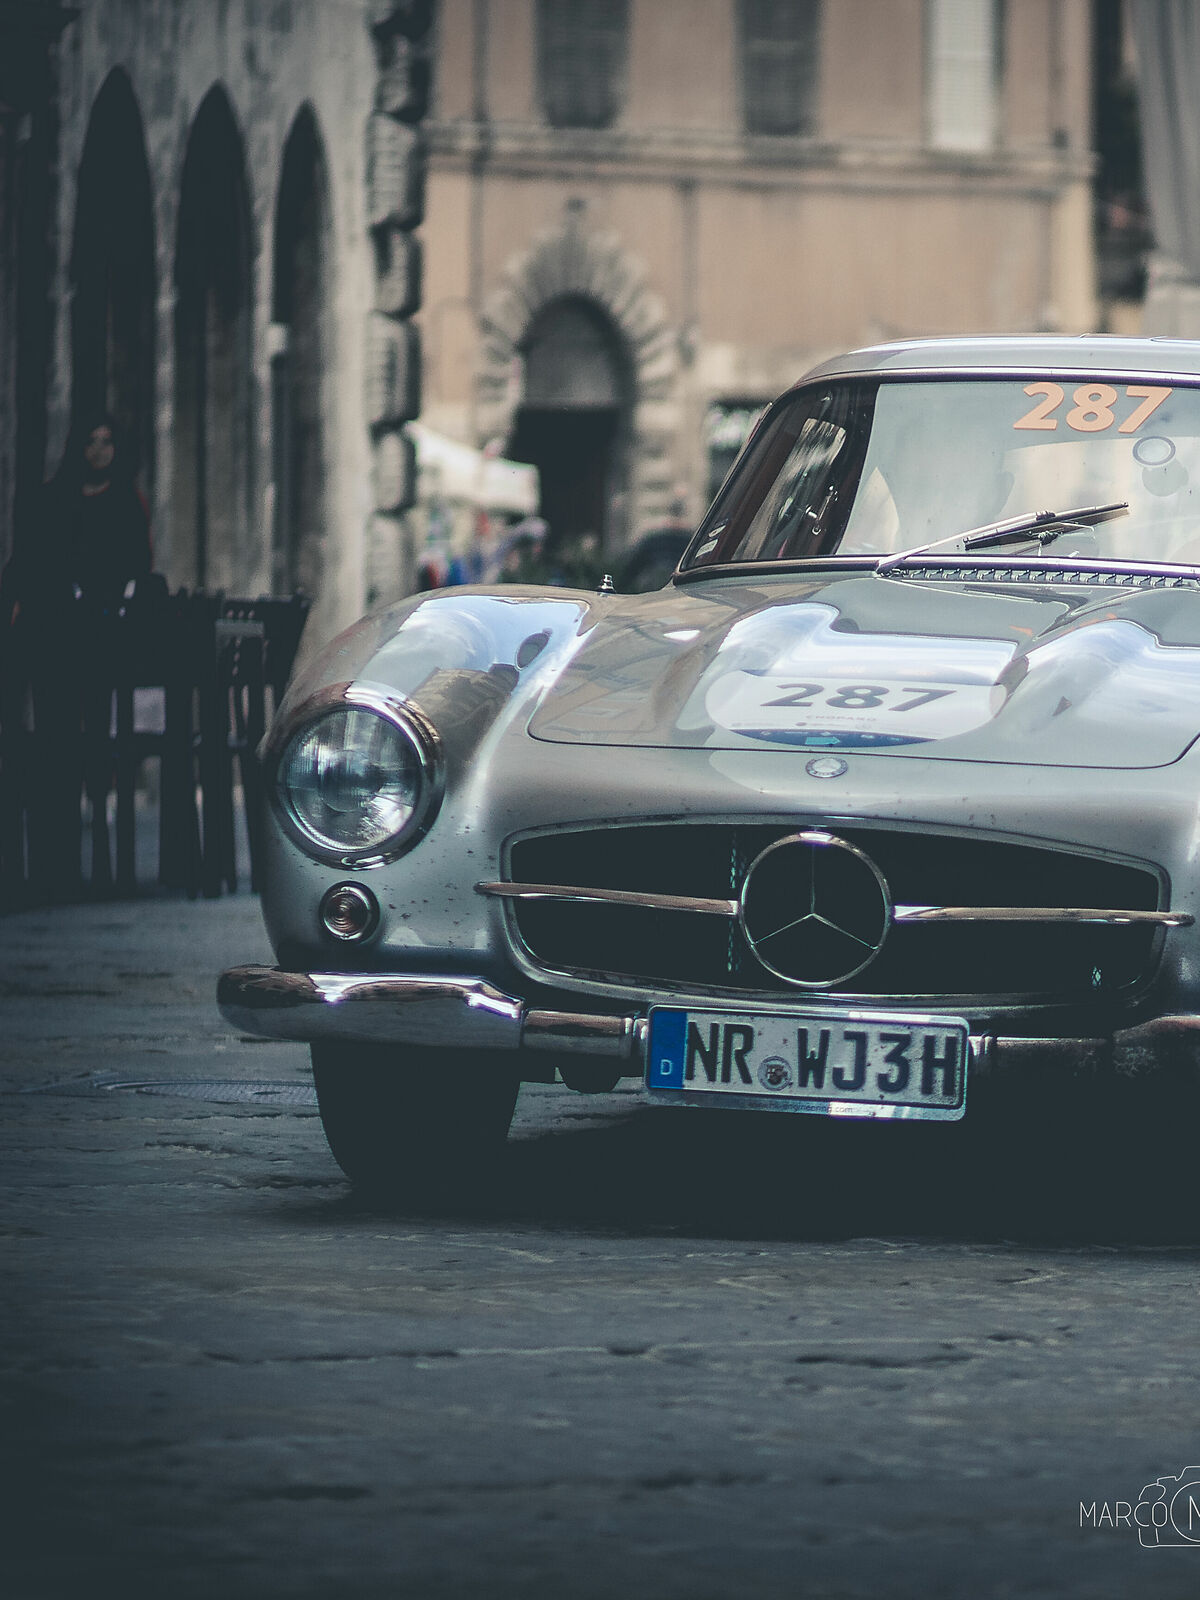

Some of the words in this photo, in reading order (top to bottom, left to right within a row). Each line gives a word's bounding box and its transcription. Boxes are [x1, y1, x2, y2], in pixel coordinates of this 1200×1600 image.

[1013, 381, 1173, 434] 287
[760, 683, 957, 712] 287
[660, 1059, 673, 1076] D
[685, 1021, 754, 1084] NR
[797, 1027, 959, 1096] WJ3H
